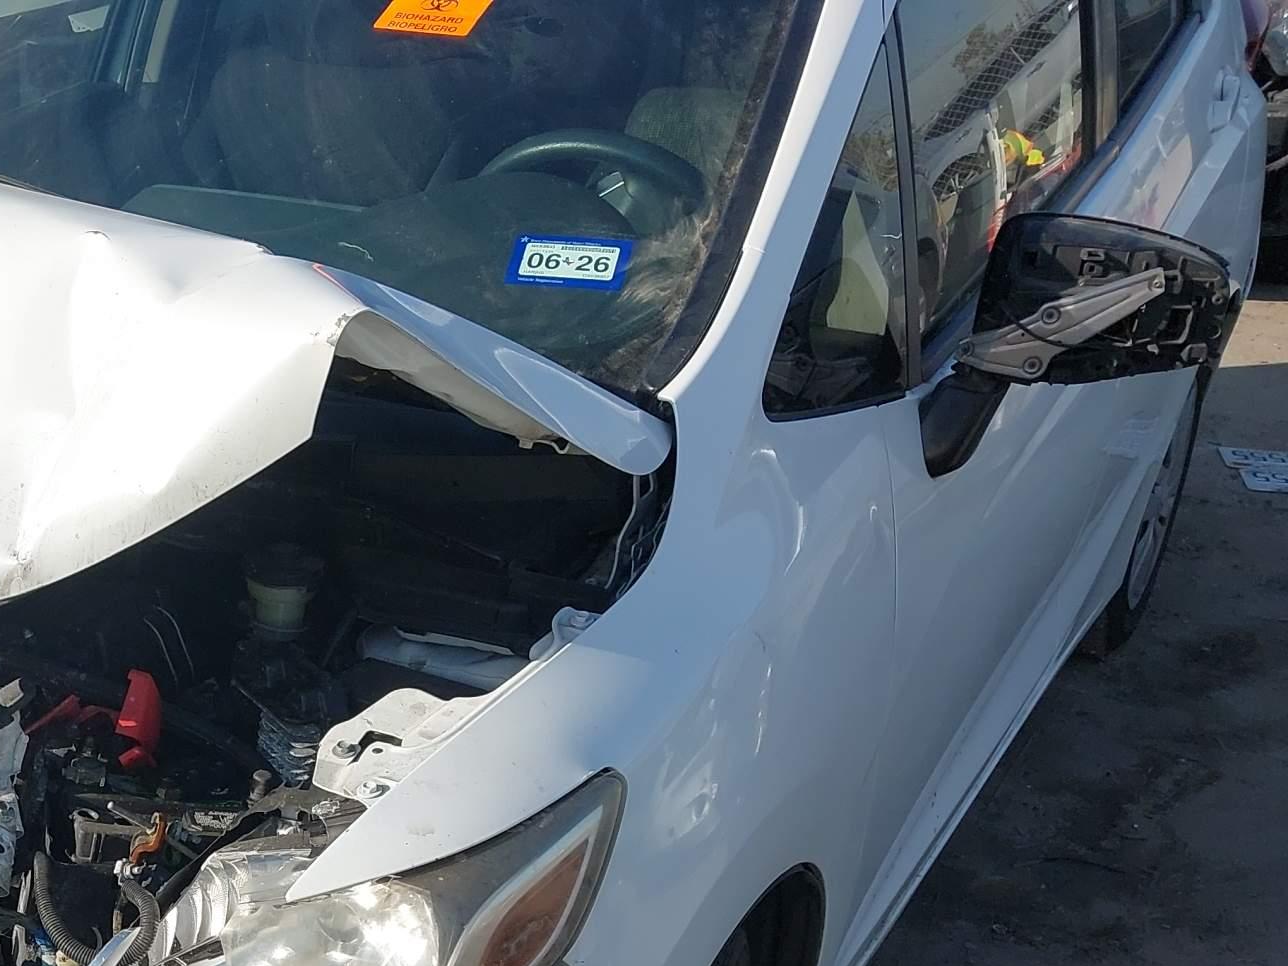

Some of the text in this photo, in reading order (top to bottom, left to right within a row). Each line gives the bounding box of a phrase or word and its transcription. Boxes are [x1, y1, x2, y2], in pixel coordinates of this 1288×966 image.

[394, 12, 464, 24] BIOHAZARD
[388, 21, 457, 33] BIOPELIGRO
[527, 252, 611, 273] 06 26
